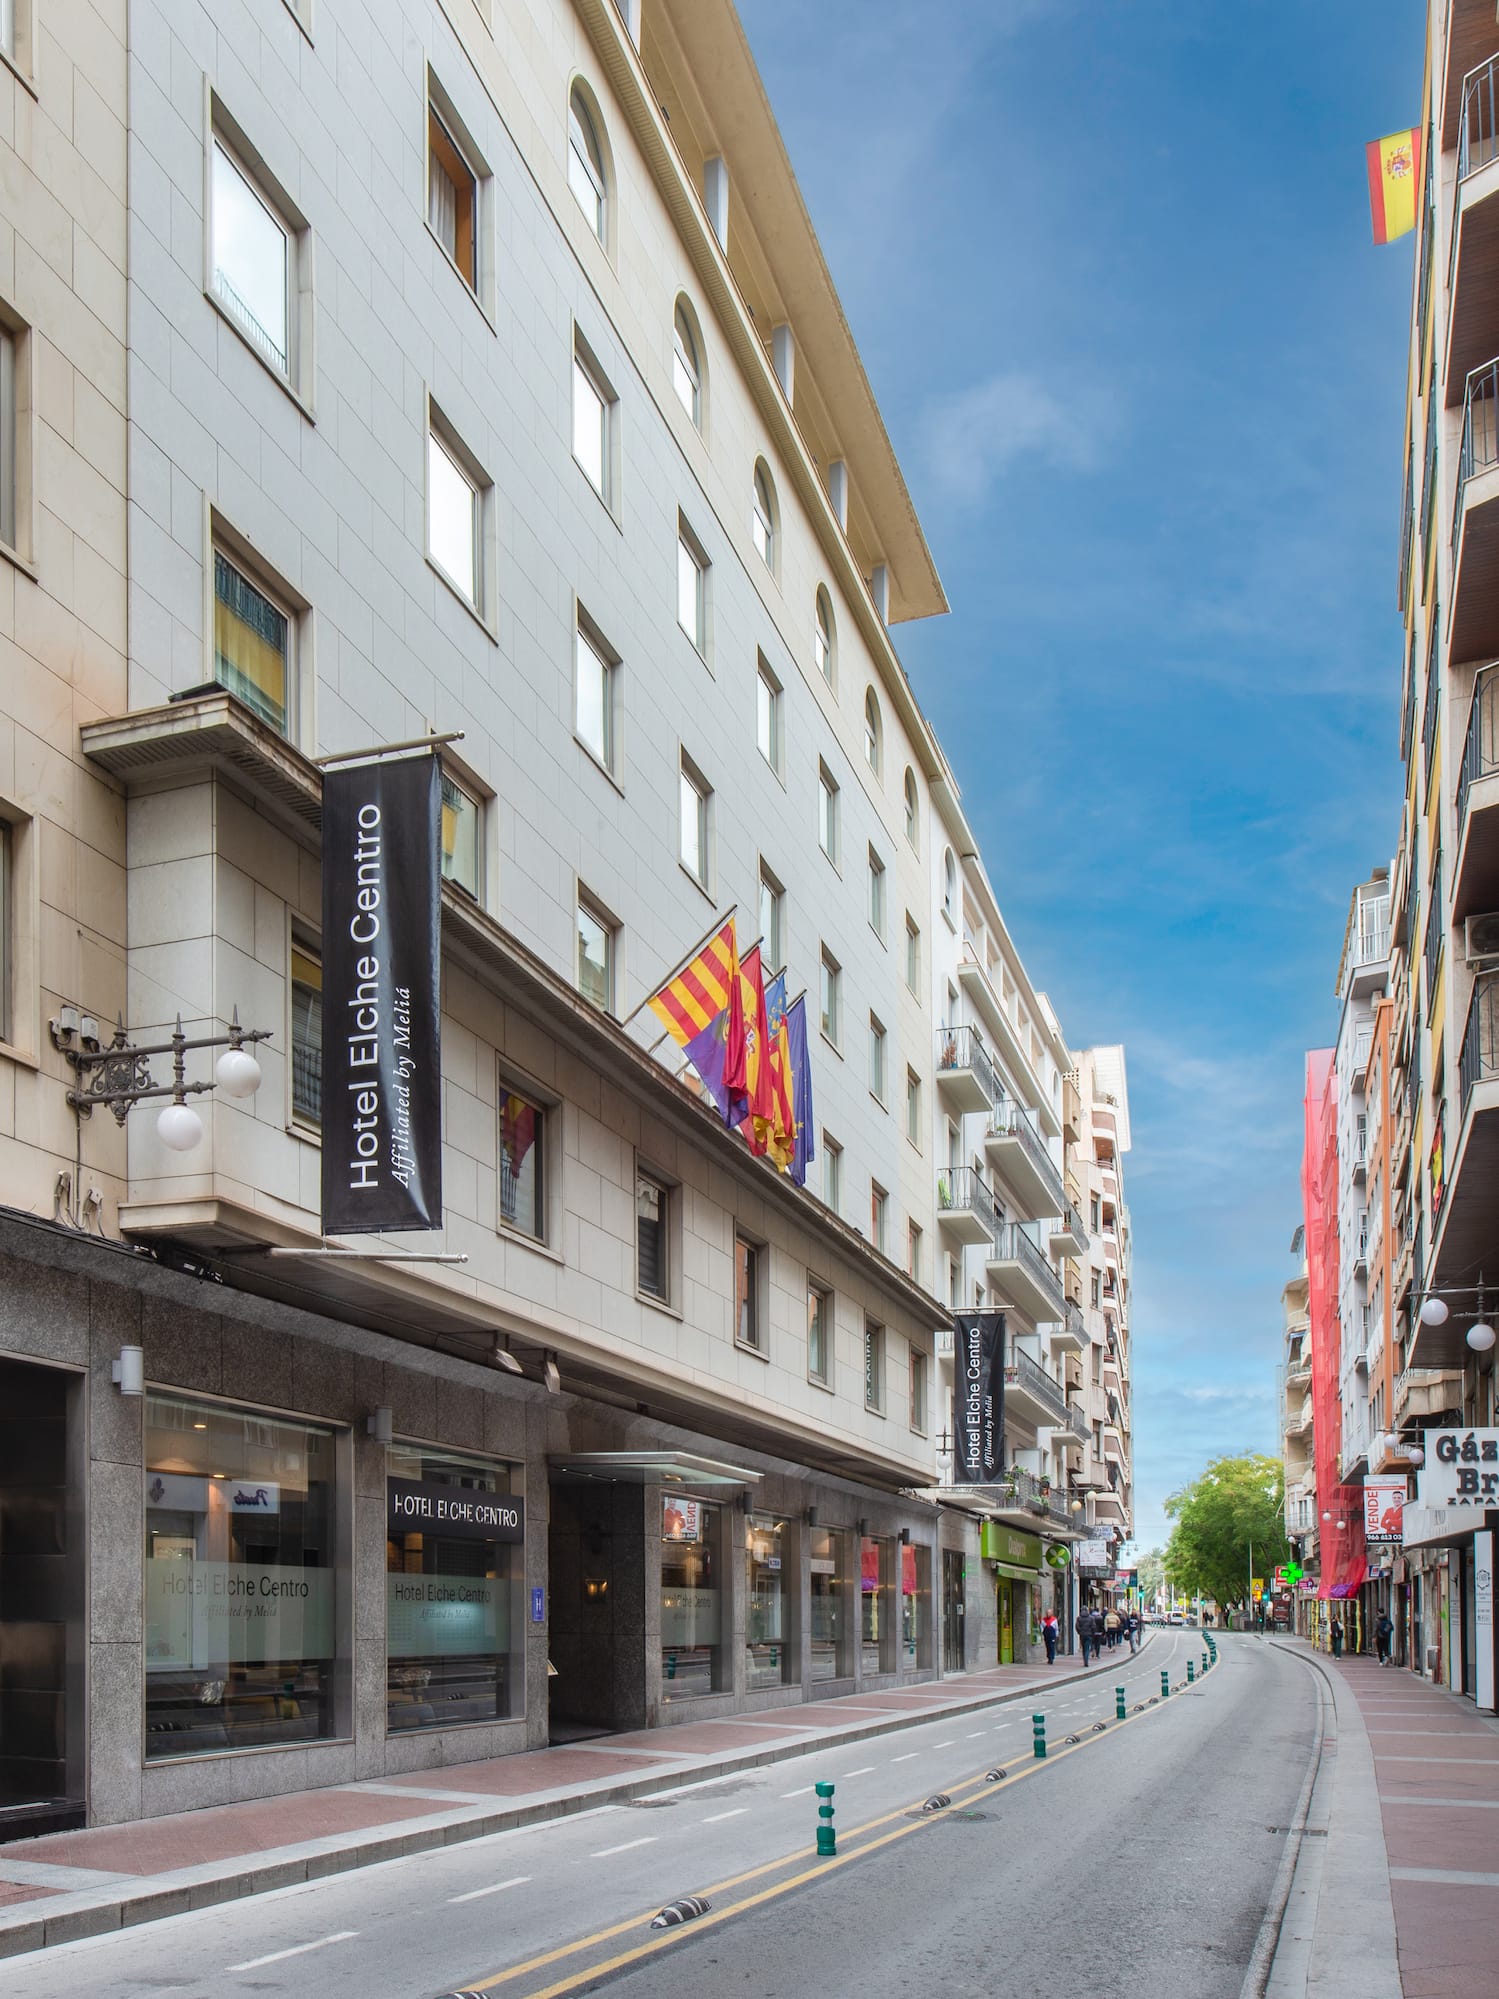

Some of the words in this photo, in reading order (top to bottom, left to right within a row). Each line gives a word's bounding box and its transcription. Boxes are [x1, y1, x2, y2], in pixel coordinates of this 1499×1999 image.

[351, 803, 381, 944] Centro
[348, 956, 380, 1067] Elche
[393, 986, 412, 1049] Meliá
[393, 1056, 417, 1079] by
[350, 1080, 379, 1189] Hotel
[391, 1084, 414, 1189] Affiliated
[966, 1327, 981, 1379] Centro
[966, 1383, 980, 1424] Elche
[984, 1417, 995, 1430] by
[966, 1428, 980, 1468] Hotel
[983, 1431, 994, 1469] Affiliated
[1436, 1432, 1498, 1462] Gáz
[1456, 1468, 1499, 1494] Br
[394, 1494, 434, 1518] HOTEL
[438, 1500, 473, 1522] ELCHE
[476, 1505, 518, 1527] CENTRO
[1367, 1490, 1379, 1533] VENDE
[162, 1572, 207, 1595] Hotel
[213, 1574, 255, 1596] Elche
[260, 1576, 309, 1598] Centro
[395, 1584, 424, 1601] Hotel
[428, 1584, 455, 1602] Elche
[458, 1585, 491, 1603] Centro
